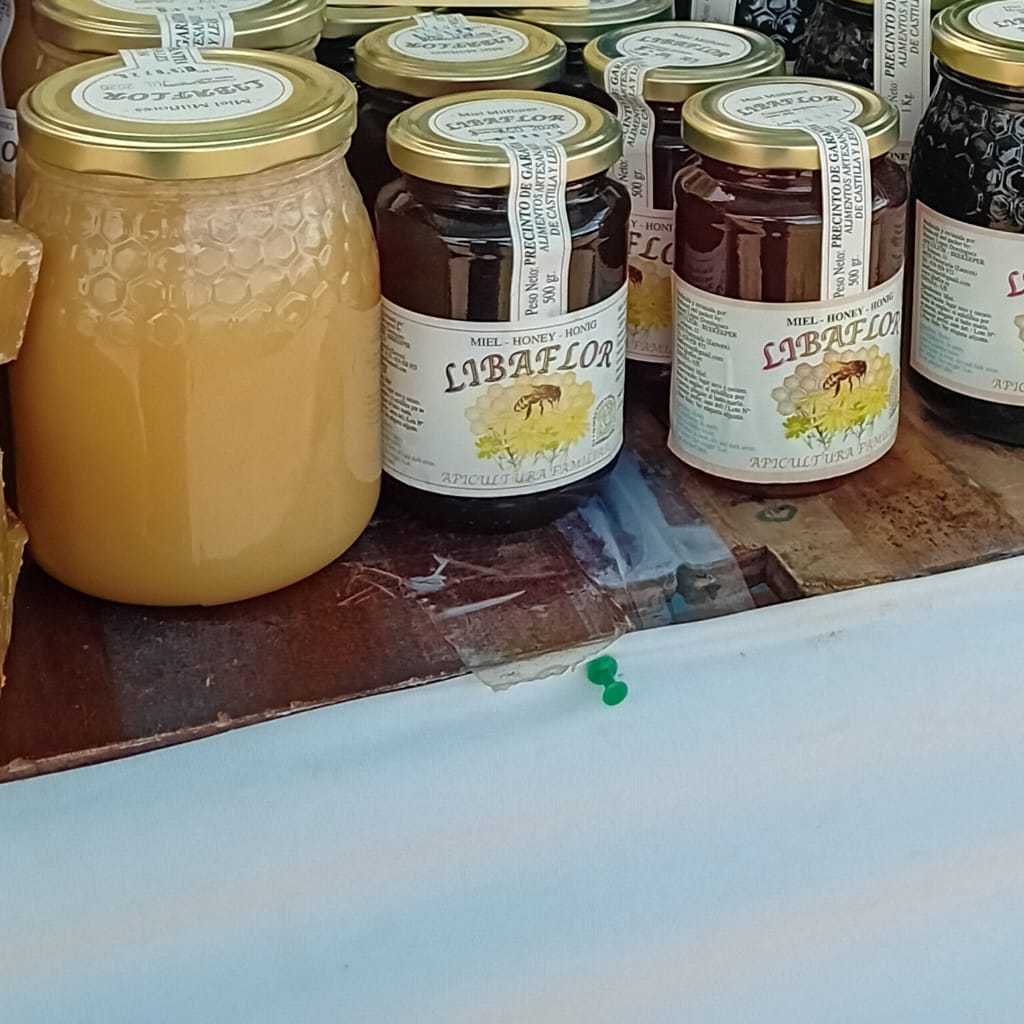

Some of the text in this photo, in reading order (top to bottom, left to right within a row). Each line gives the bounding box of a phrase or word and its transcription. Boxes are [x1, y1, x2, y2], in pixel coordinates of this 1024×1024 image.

[884, 16, 897, 78] PRECINTO
[897, 11, 909, 68] ALIMENTOS
[102, 79, 265, 102] LIBAFLOR
[444, 113, 567, 132] LIBAFLOR
[830, 167, 842, 187] DE
[852, 158, 864, 203] CASTILLA
[519, 182, 532, 201] DE
[547, 177, 560, 220] CASTILLA
[844, 177, 853, 234] ALIMENTOS
[538, 193, 550, 253] ALIMENTOS
[550, 222, 561, 236] DE
[831, 188, 843, 249] PRECINTO
[520, 201, 537, 266] PRECINTO
[848, 266, 860, 286] 500
[542, 284, 556, 304] 500
[834, 280, 845, 299] Peso
[525, 293, 539, 316] Peso
[786, 315, 819, 327] MIEL
[826, 307, 864, 323] HONEY
[470, 320, 598, 347] MIEL HONEY HONIG
[444, 338, 615, 394] LIBAFLOR
[750, 447, 854, 470] APICULTURA
[441, 467, 547, 487] APICULTURA
